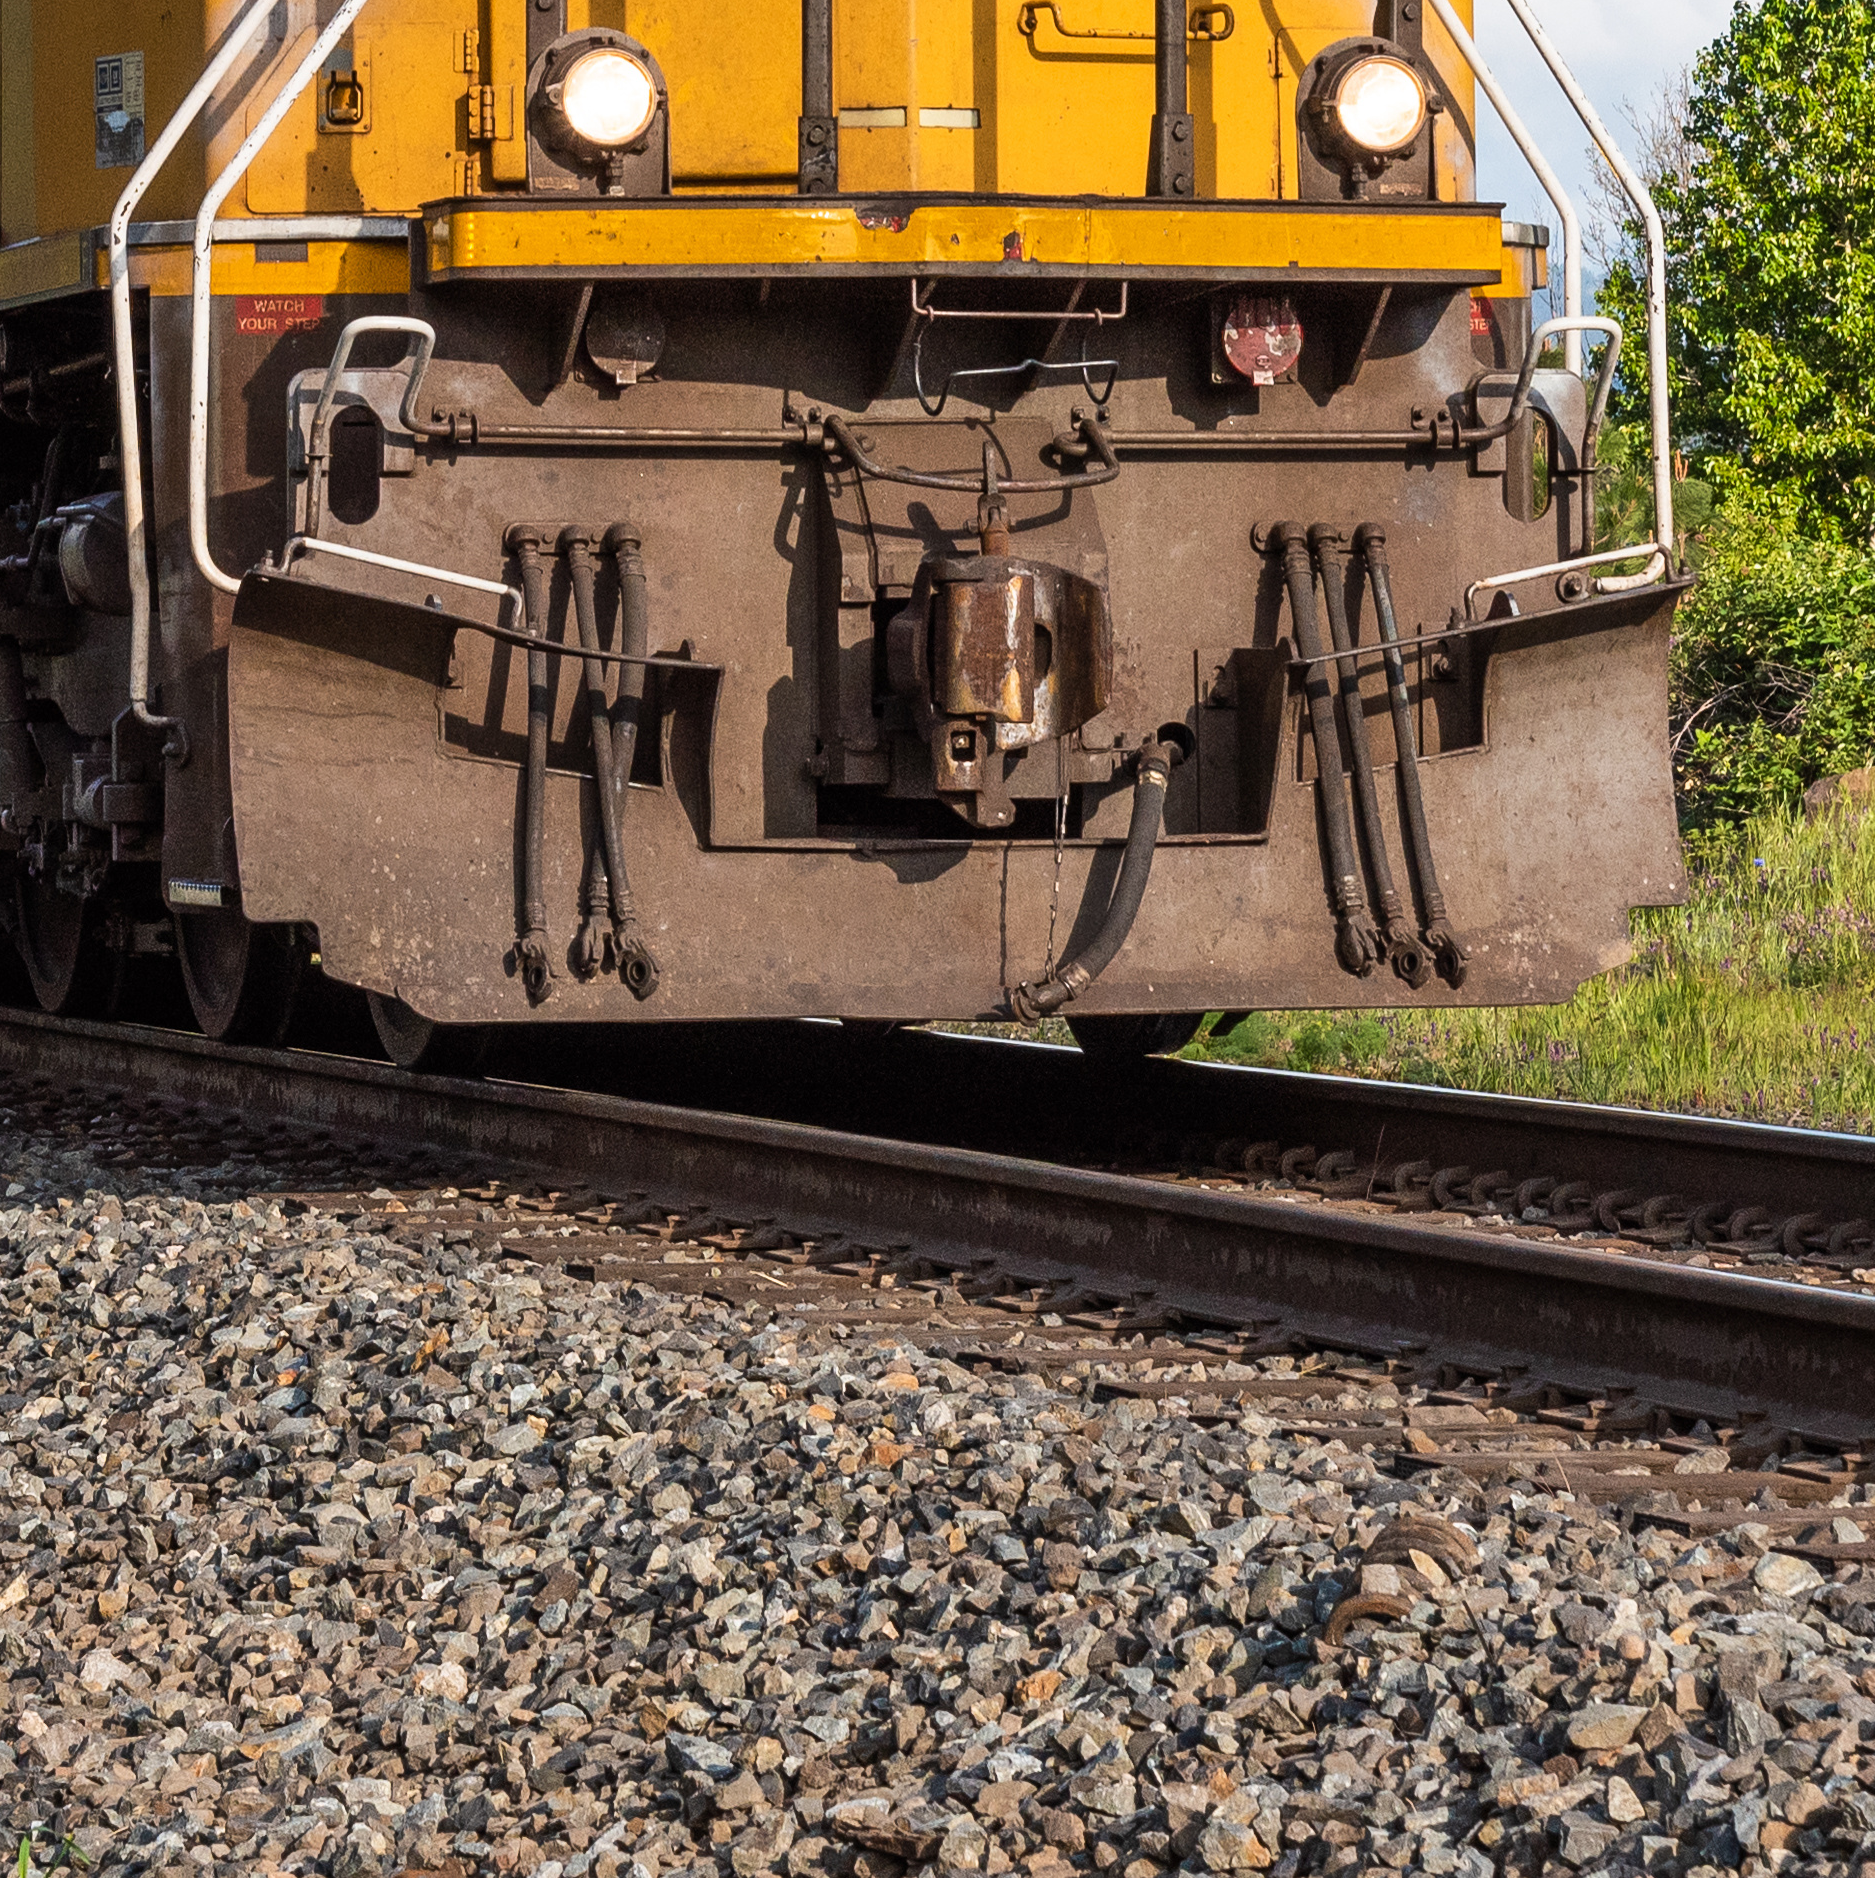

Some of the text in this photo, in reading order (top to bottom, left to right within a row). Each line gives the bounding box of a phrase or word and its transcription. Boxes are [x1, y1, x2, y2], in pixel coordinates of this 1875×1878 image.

[254, 299, 304, 312] WATCH
[238, 316, 320, 330] YOUR STEP
